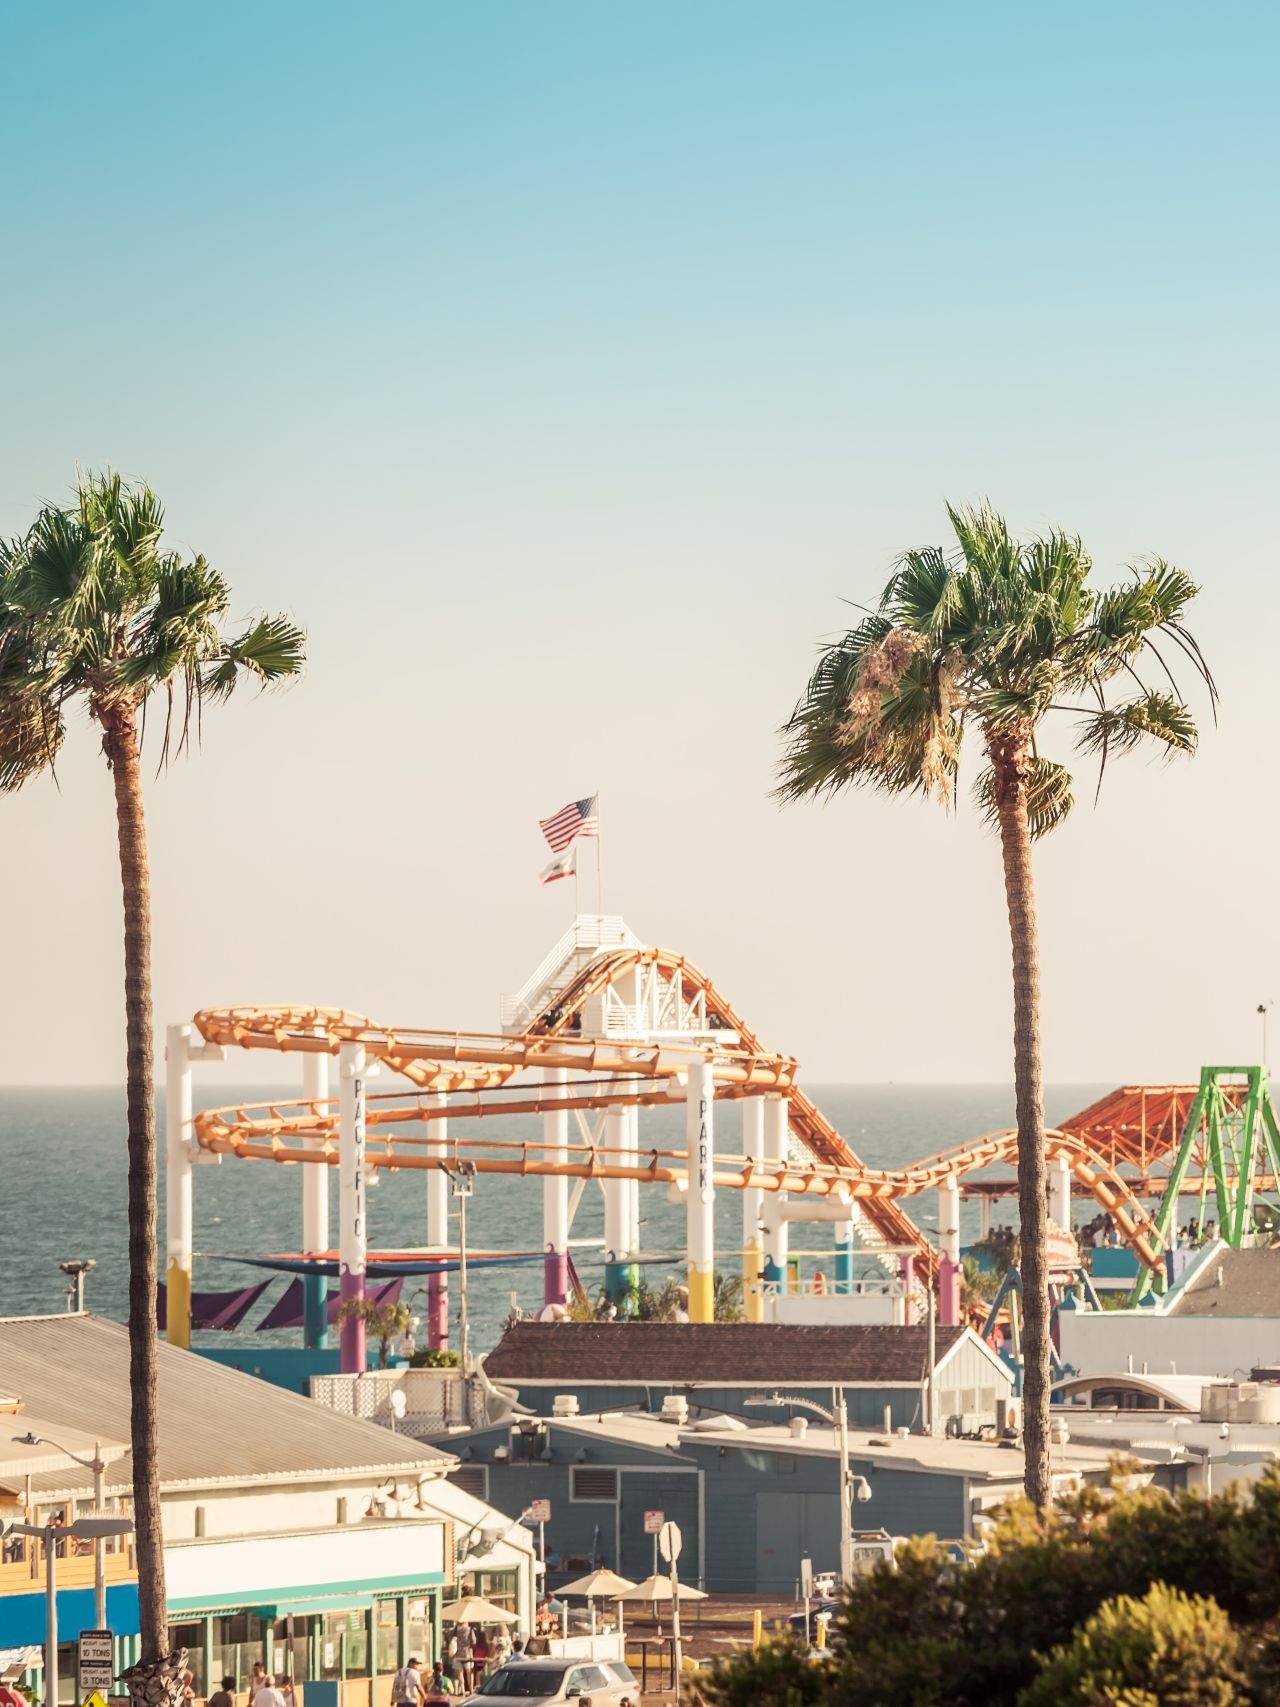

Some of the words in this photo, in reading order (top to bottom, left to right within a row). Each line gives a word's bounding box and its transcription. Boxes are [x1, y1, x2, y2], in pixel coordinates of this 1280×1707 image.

[354, 1079, 362, 1237] PACIFIC
[82, 1649, 89, 1657] 10
[92, 1649, 110, 1657] TONS
[83, 1676, 88, 1685] 3
[91, 1676, 110, 1685] TONS
